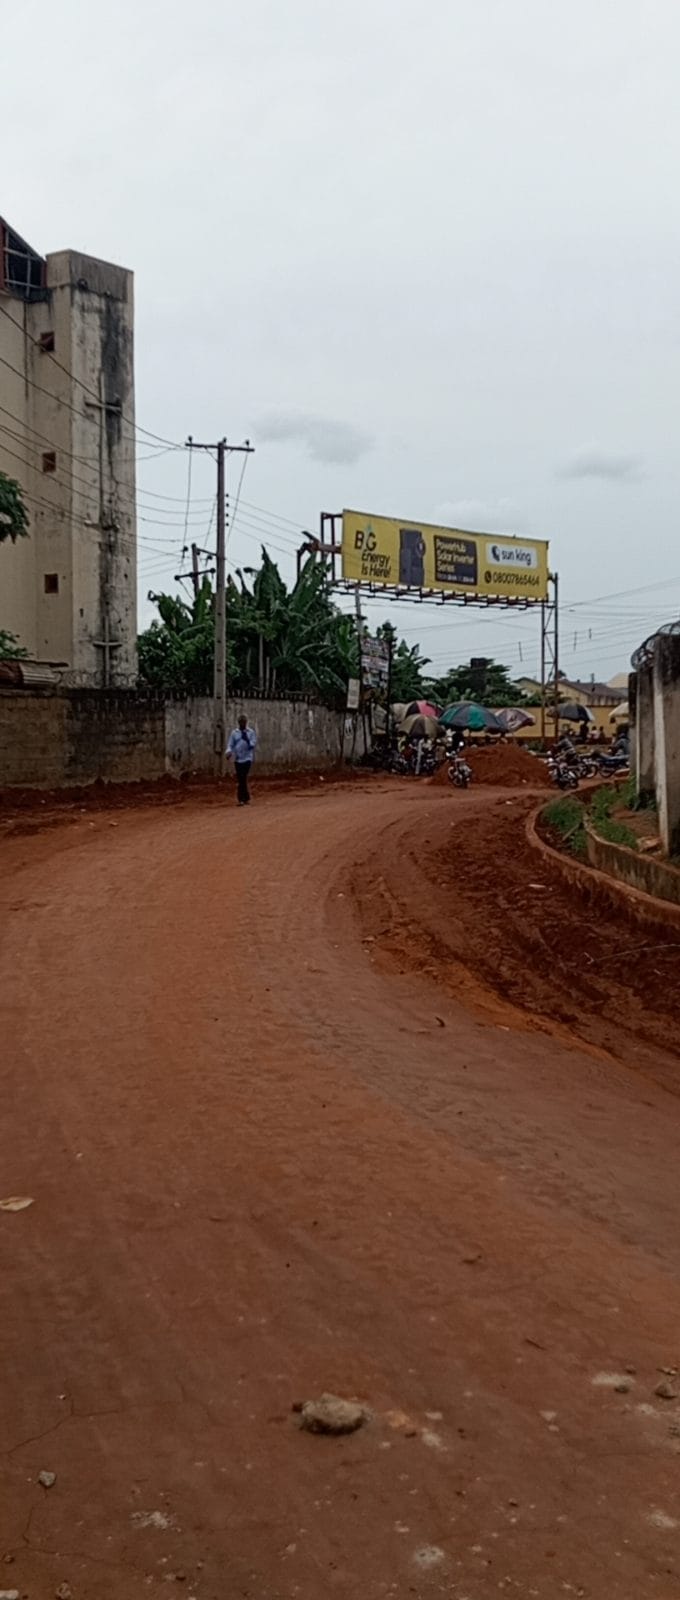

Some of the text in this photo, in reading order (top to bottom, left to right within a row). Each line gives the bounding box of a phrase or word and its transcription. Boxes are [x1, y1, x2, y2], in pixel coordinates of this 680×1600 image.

[361, 549, 391, 568] Energy
[501, 548, 531, 566] sun king
[361, 563, 368, 576] Is
